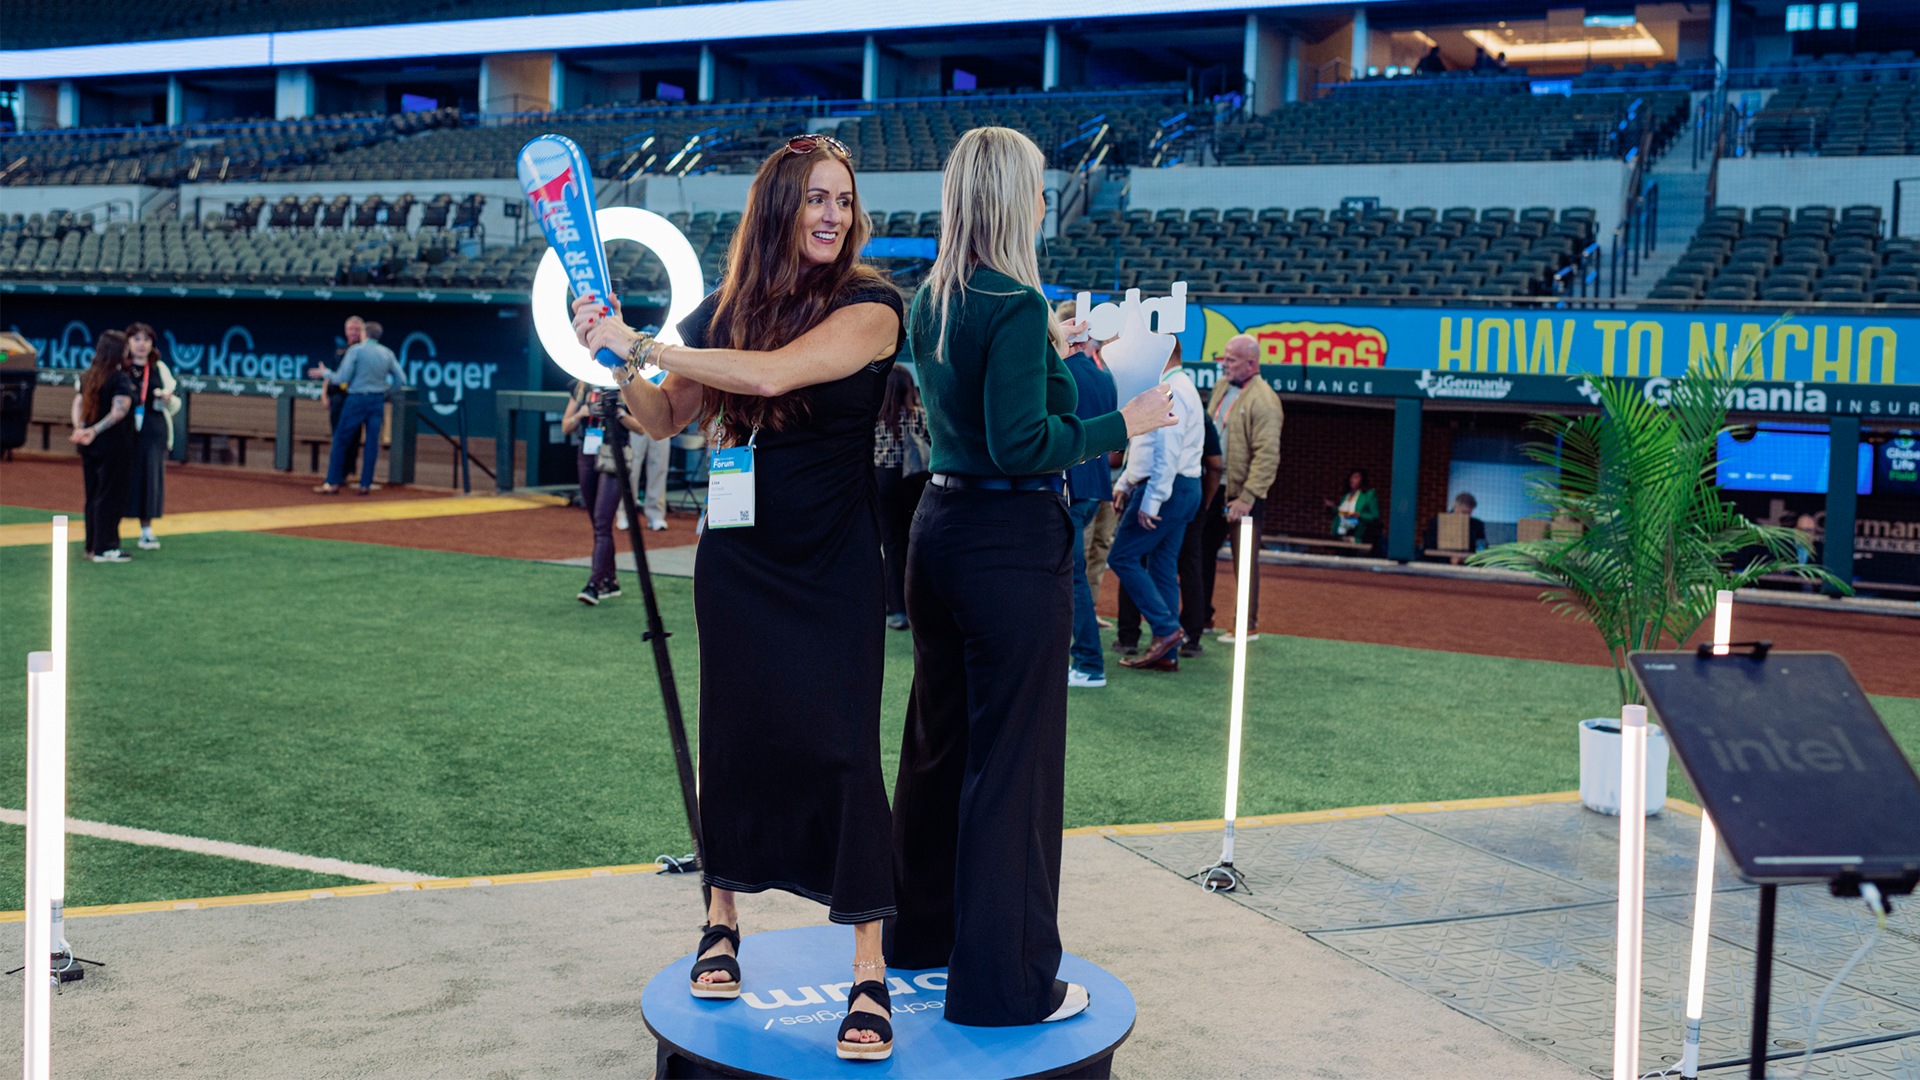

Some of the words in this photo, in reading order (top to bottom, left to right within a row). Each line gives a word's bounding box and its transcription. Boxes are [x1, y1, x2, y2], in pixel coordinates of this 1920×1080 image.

[564, 250, 604, 306] PER
[50, 320, 97, 369] Kro
[207, 324, 309, 380] Kroger
[1438, 317, 1576, 374] HOW
[1593, 319, 1663, 377] TO
[1688, 321, 1898, 385] NACHO
[1266, 378, 1373, 394] SURANCE
[1644, 377, 1828, 413] Gmania
[1892, 459, 1916, 471] Life
[1701, 726, 1866, 772] intel
[740, 972, 948, 1010] orum
